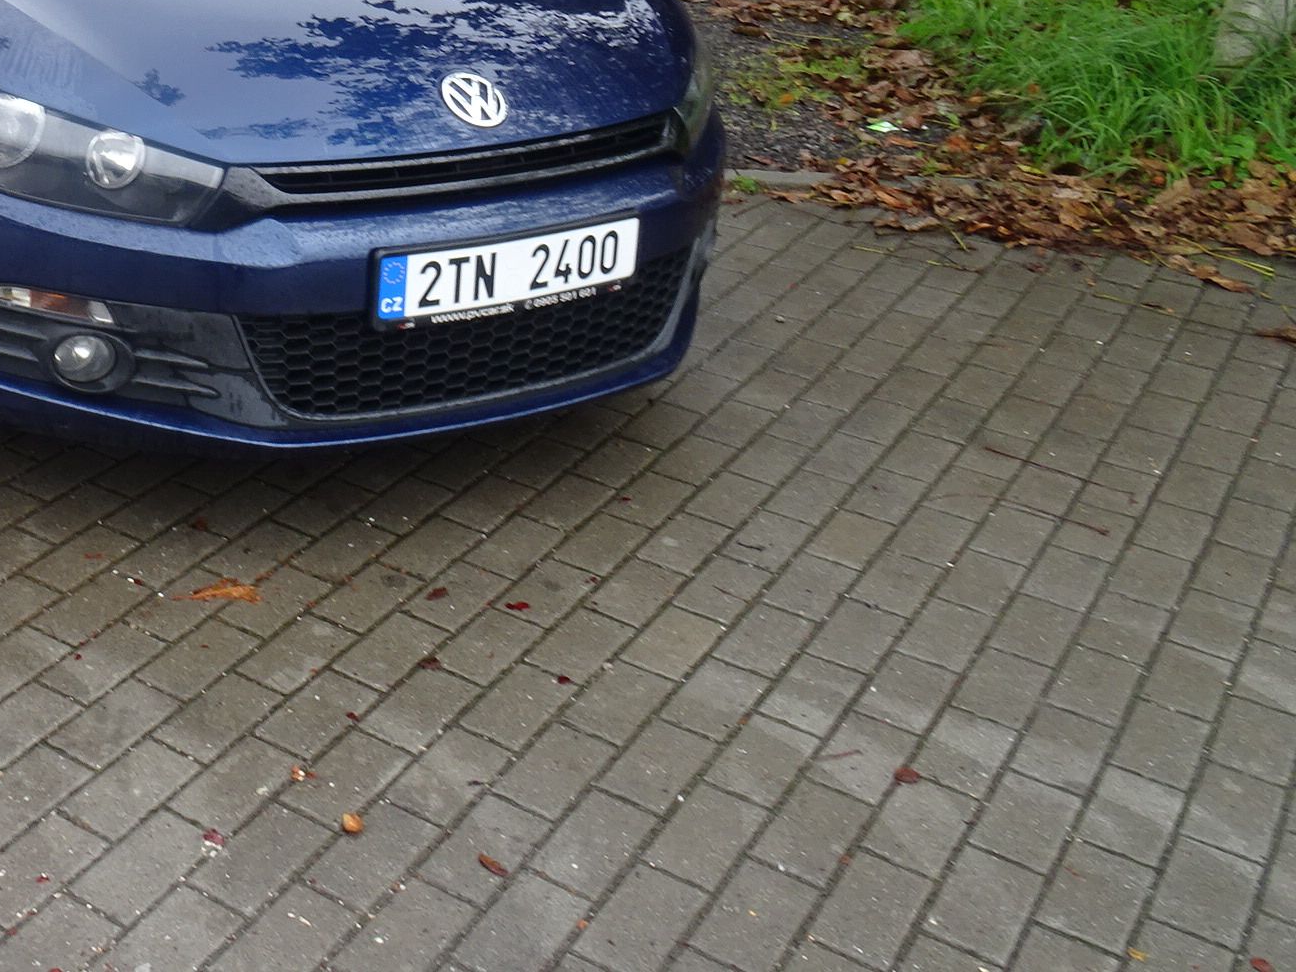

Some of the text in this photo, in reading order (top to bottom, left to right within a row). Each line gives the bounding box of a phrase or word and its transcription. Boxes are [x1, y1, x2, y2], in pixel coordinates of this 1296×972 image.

[417, 229, 619, 309] 2TN 2400
[381, 296, 404, 314] CZ
